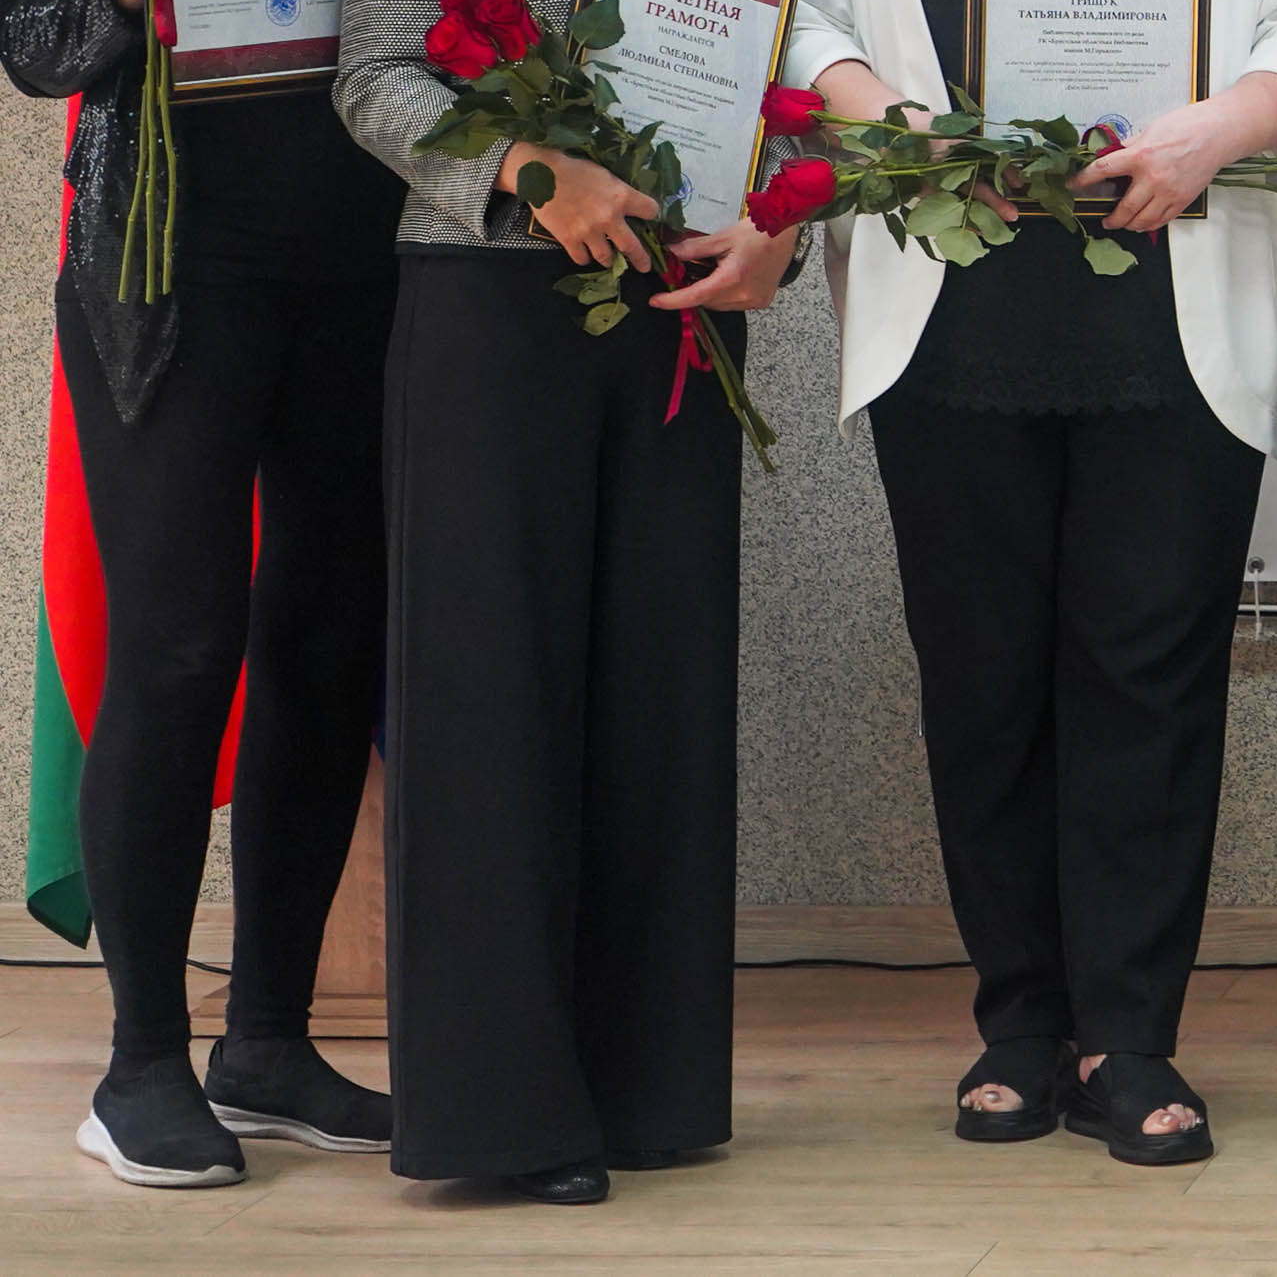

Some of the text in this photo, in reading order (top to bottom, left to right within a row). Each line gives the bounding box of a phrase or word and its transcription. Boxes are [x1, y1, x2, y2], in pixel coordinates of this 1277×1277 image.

[646, 1, 729, 38] ГРАМОТА
[1018, 10, 1167, 21] ТАТЬЯНА ВЛАДИМИРОВНА
[618, 48, 738, 90] ЛЮДМИЛА СТЕПАНОВНА
[659, 45, 705, 66] СМЕЛОВА
